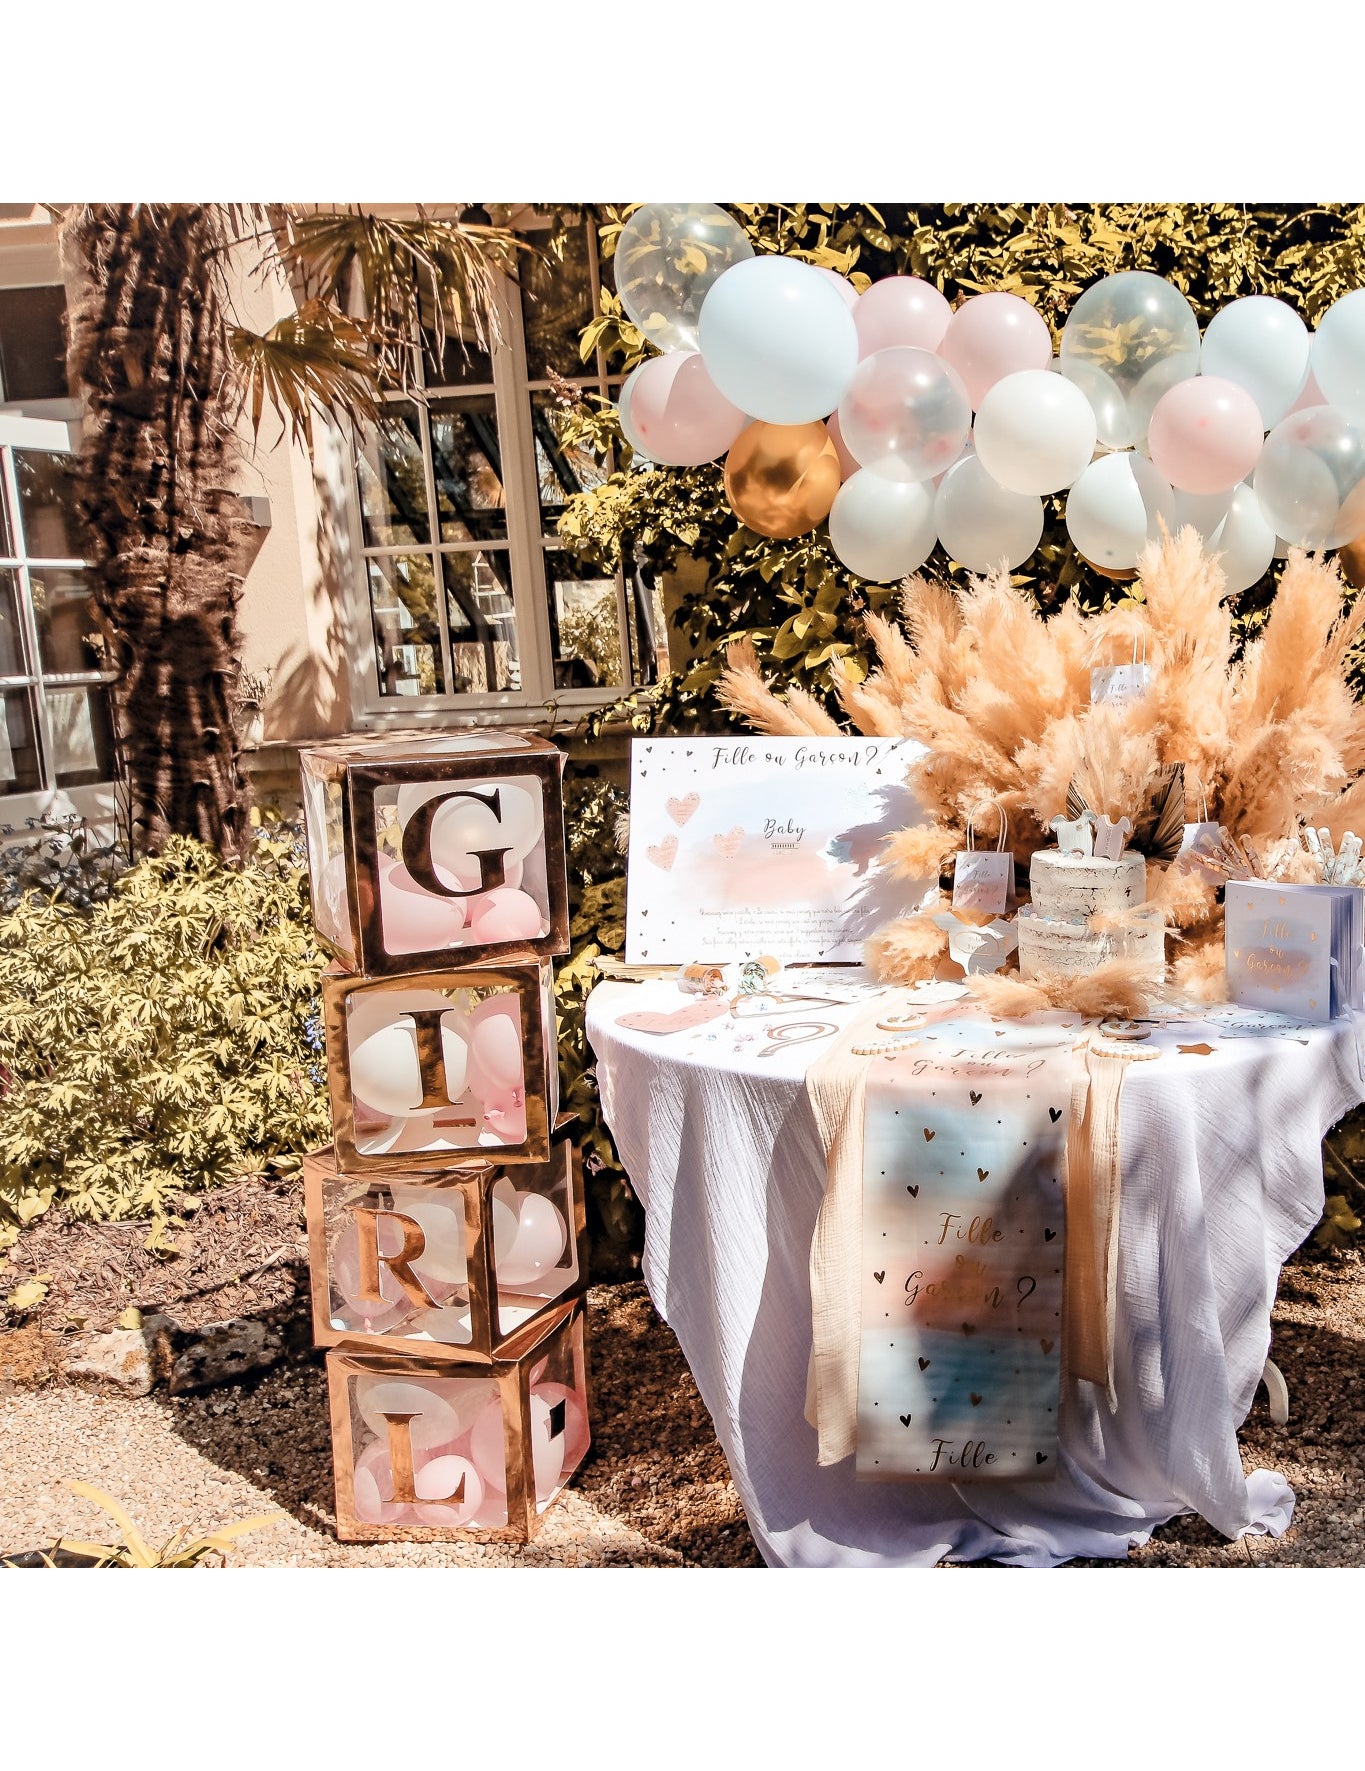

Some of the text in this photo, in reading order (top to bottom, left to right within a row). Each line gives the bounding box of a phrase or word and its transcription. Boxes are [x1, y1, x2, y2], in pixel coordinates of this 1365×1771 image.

[712, 746, 757, 770] Fille
[765, 752, 787, 767] ou
[763, 817, 807, 842] Baby
[951, 1049, 1026, 1060] Fille
[937, 1212, 1006, 1246] Fille
[929, 1438, 999, 1472] Fille
